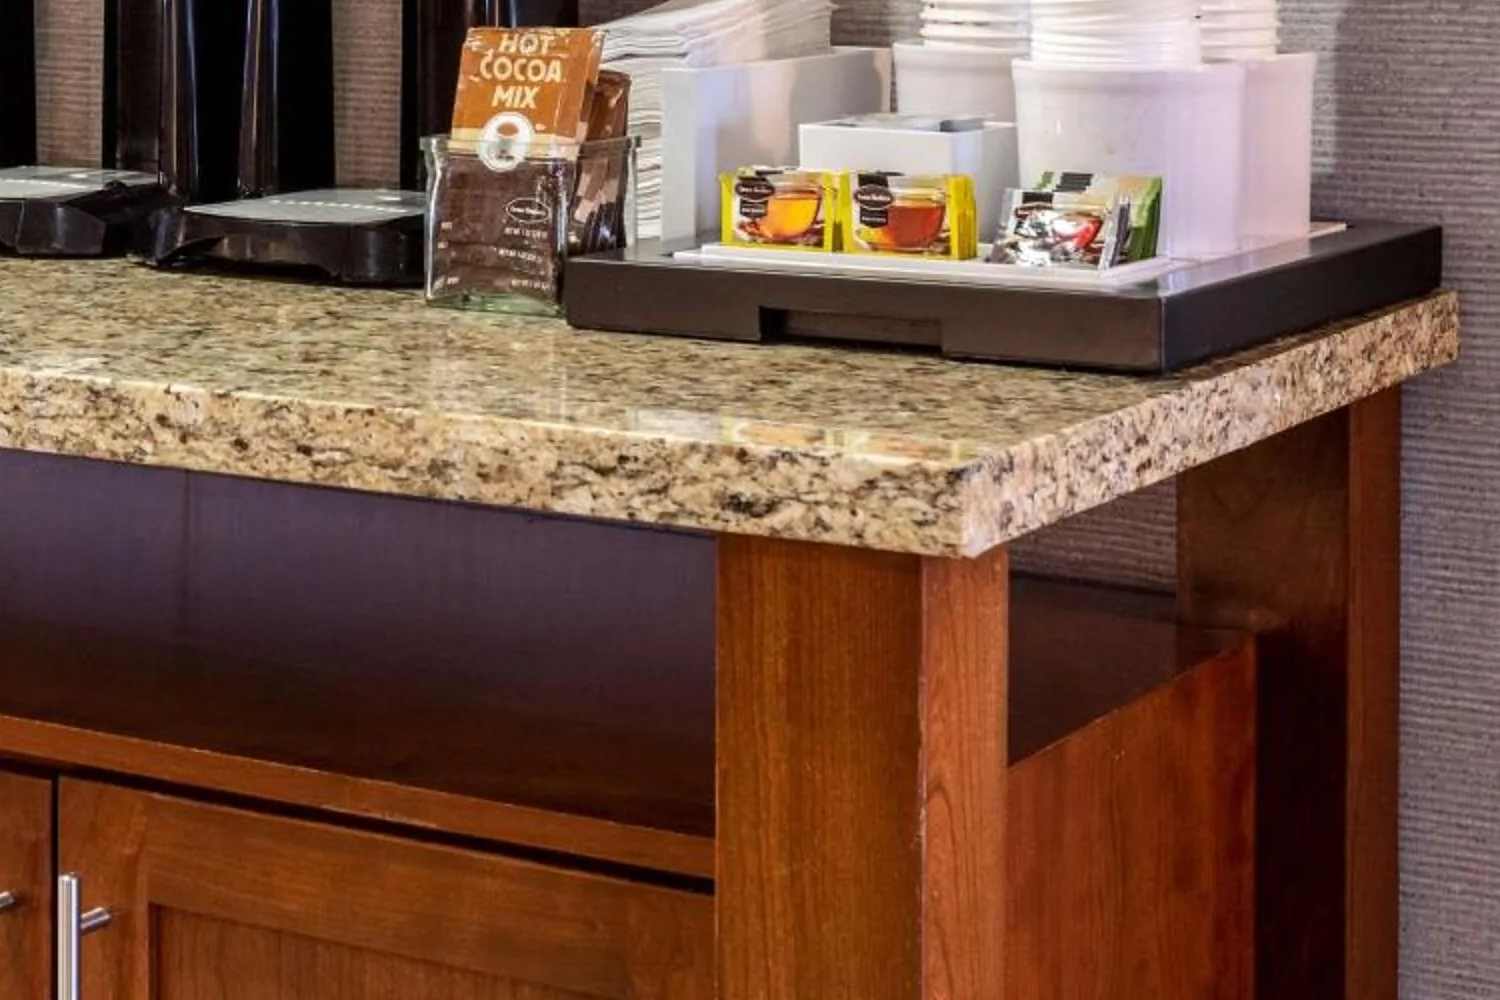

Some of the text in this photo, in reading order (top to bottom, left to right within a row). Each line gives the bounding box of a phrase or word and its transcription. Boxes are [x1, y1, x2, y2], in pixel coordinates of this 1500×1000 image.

[499, 32, 556, 55] HOT
[480, 53, 562, 82] COCOA
[491, 84, 540, 109] MIX
